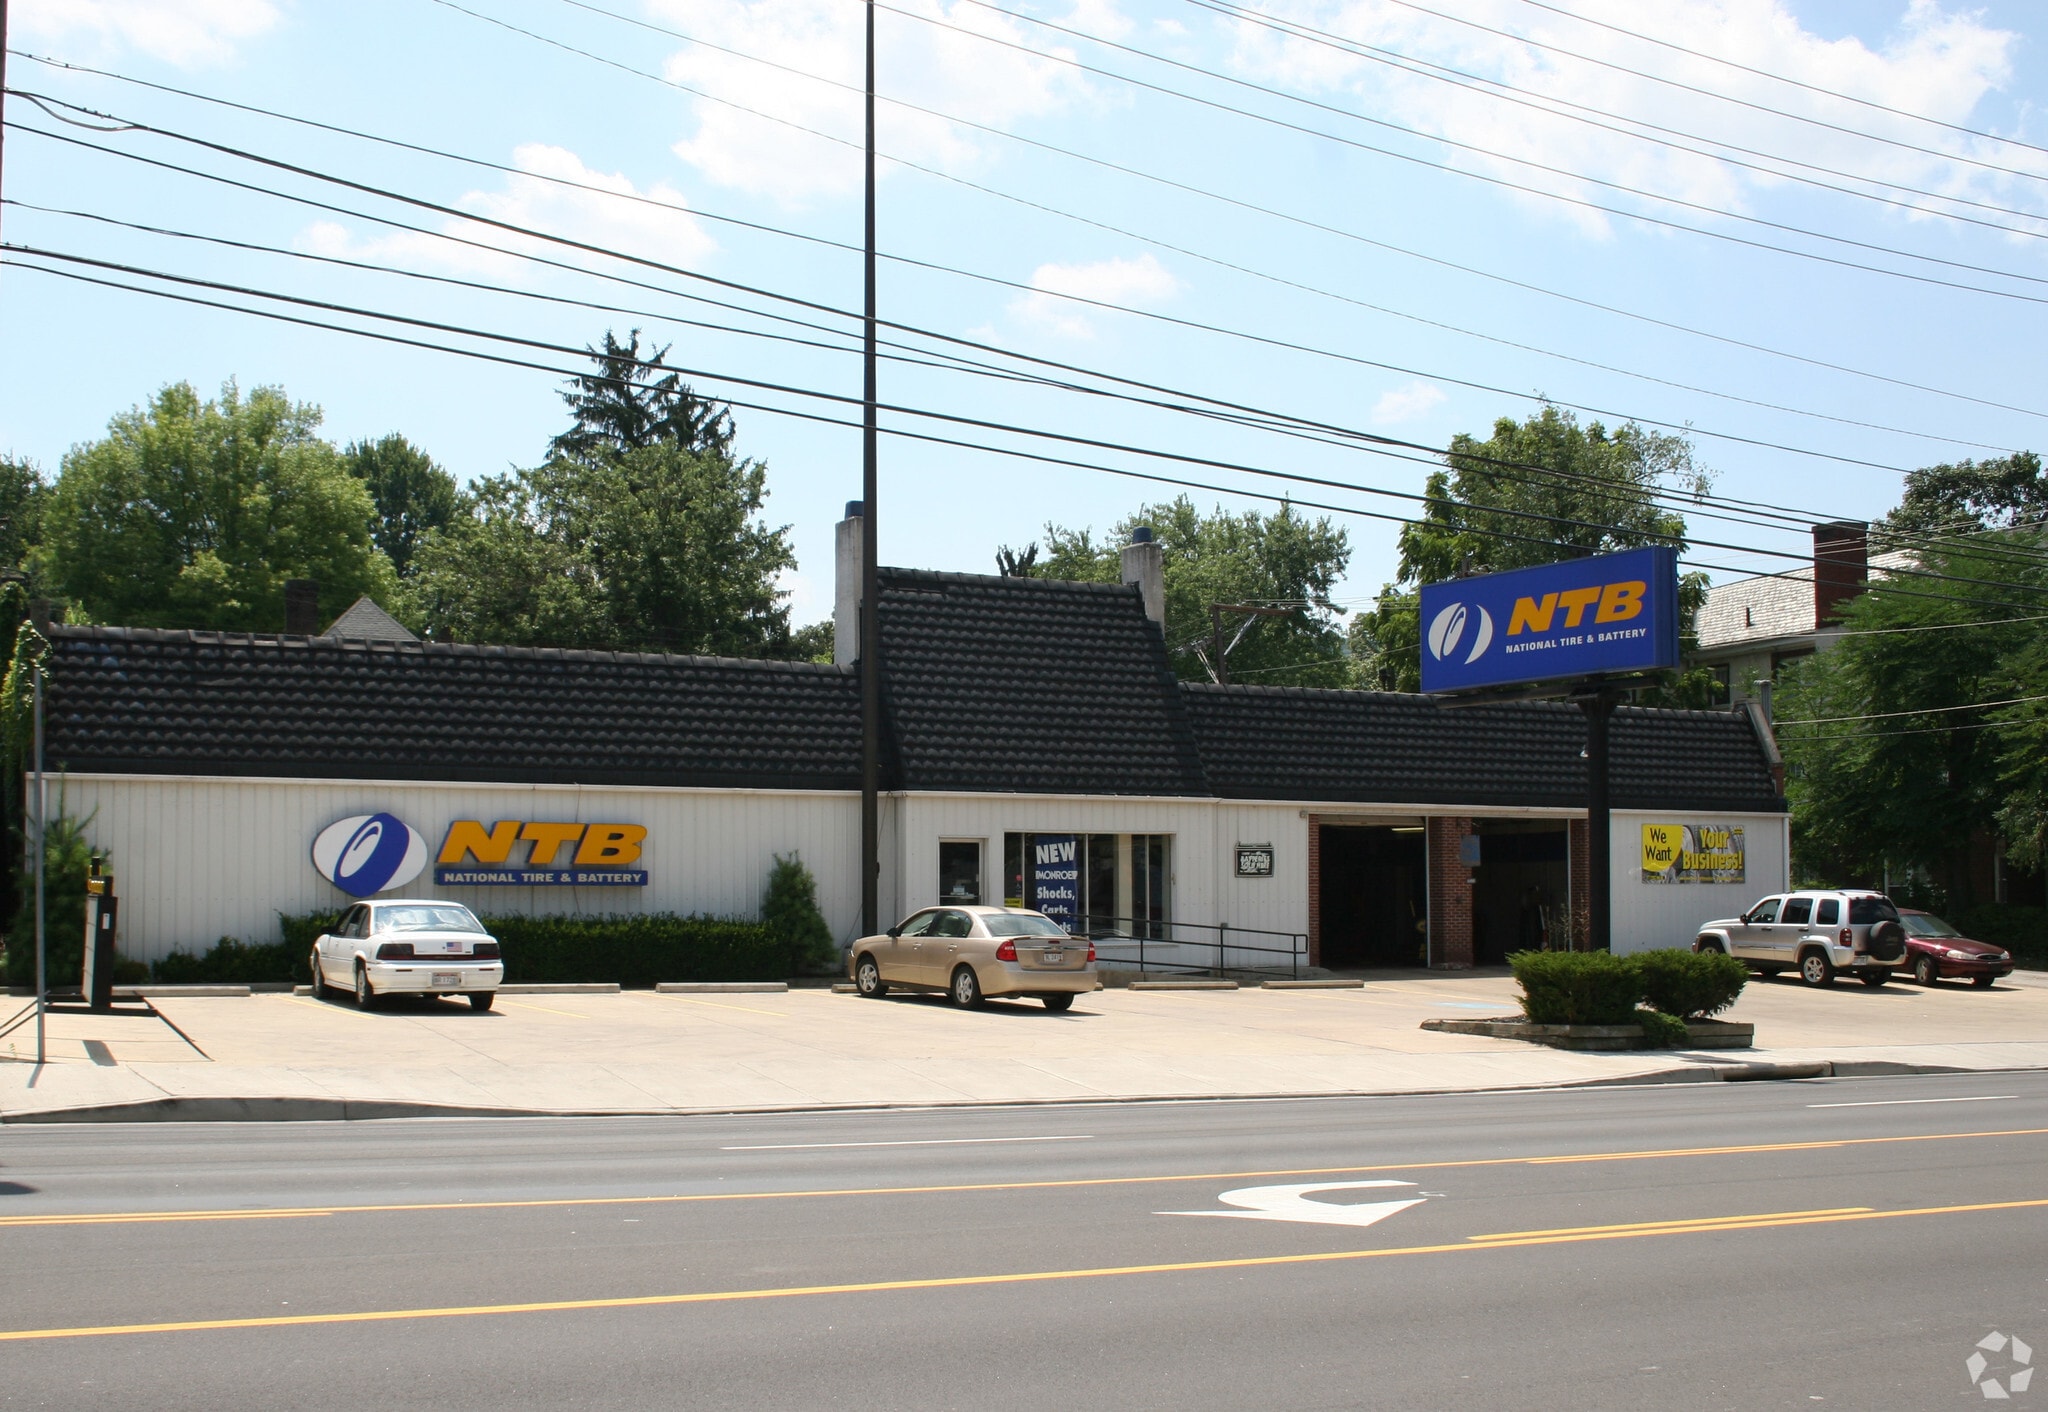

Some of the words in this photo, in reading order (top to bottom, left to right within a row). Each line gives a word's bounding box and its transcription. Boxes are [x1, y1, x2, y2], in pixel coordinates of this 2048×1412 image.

[1506, 580, 1647, 636] NTB
[1505, 640, 1557, 654] NATIONAL
[1560, 635, 1583, 647] TIRE
[1586, 634, 1595, 644] &
[1598, 628, 1647, 642] BATTERY
[438, 820, 647, 865] NTB
[1649, 827, 1667, 844] We
[1700, 828, 1730, 849] Your
[1035, 841, 1076, 865] NEW
[1645, 844, 1672, 862] Want
[1683, 849, 1744, 871] Business!
[444, 873, 516, 883] NATIONAL
[521, 873, 554, 883] TIRE
[560, 873, 571, 883] &
[577, 873, 642, 883] BATTERY
[1036, 870, 1078, 880] MONROE
[1036, 886, 1075, 901] Shocks,
